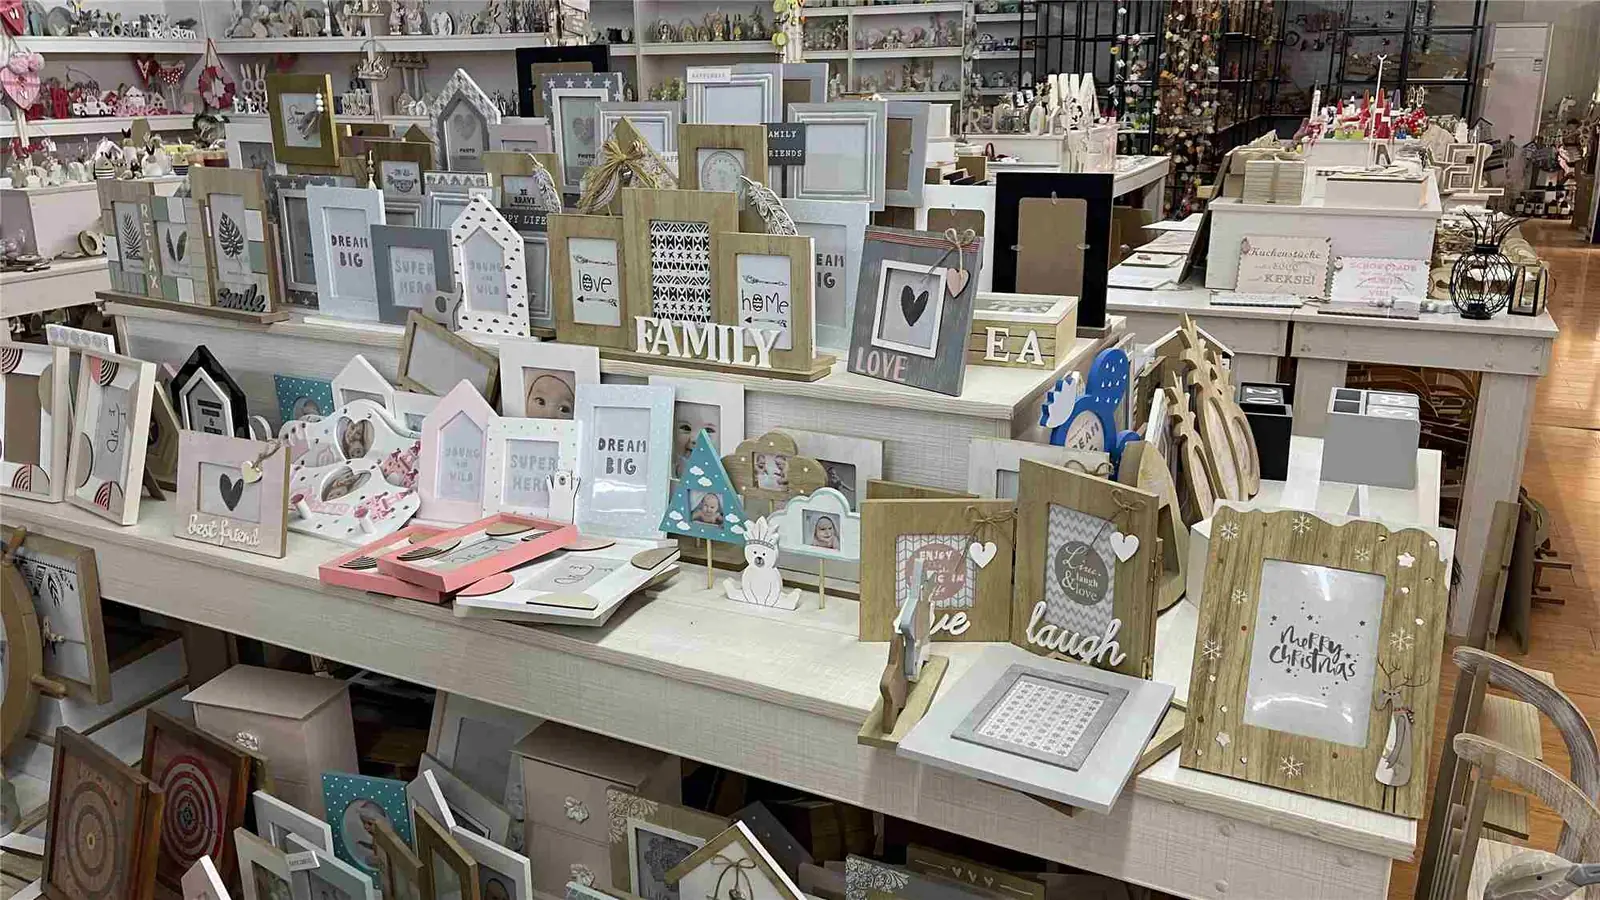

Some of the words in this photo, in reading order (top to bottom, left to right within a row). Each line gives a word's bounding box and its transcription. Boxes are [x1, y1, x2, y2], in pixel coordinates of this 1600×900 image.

[769, 130, 797, 138] AMILY
[140, 203, 159, 290] RELAX
[331, 235, 369, 248] DREAM
[339, 251, 364, 268] BIG
[394, 260, 434, 276] SUPER
[816, 253, 845, 268] EAM
[399, 280, 432, 295] HERO
[578, 269, 612, 292] love
[817, 271, 836, 289] IG
[634, 315, 782, 369] FAMILY
[854, 346, 908, 383] LOVE
[597, 437, 647, 453] DREAM
[510, 455, 559, 472] SUPER
[605, 456, 637, 475] BIG
[513, 475, 549, 492] HER
[187, 513, 218, 538] best
[219, 519, 261, 546] friend
[919, 549, 953, 560] ENJOY
[1026, 601, 1127, 667] laugh
